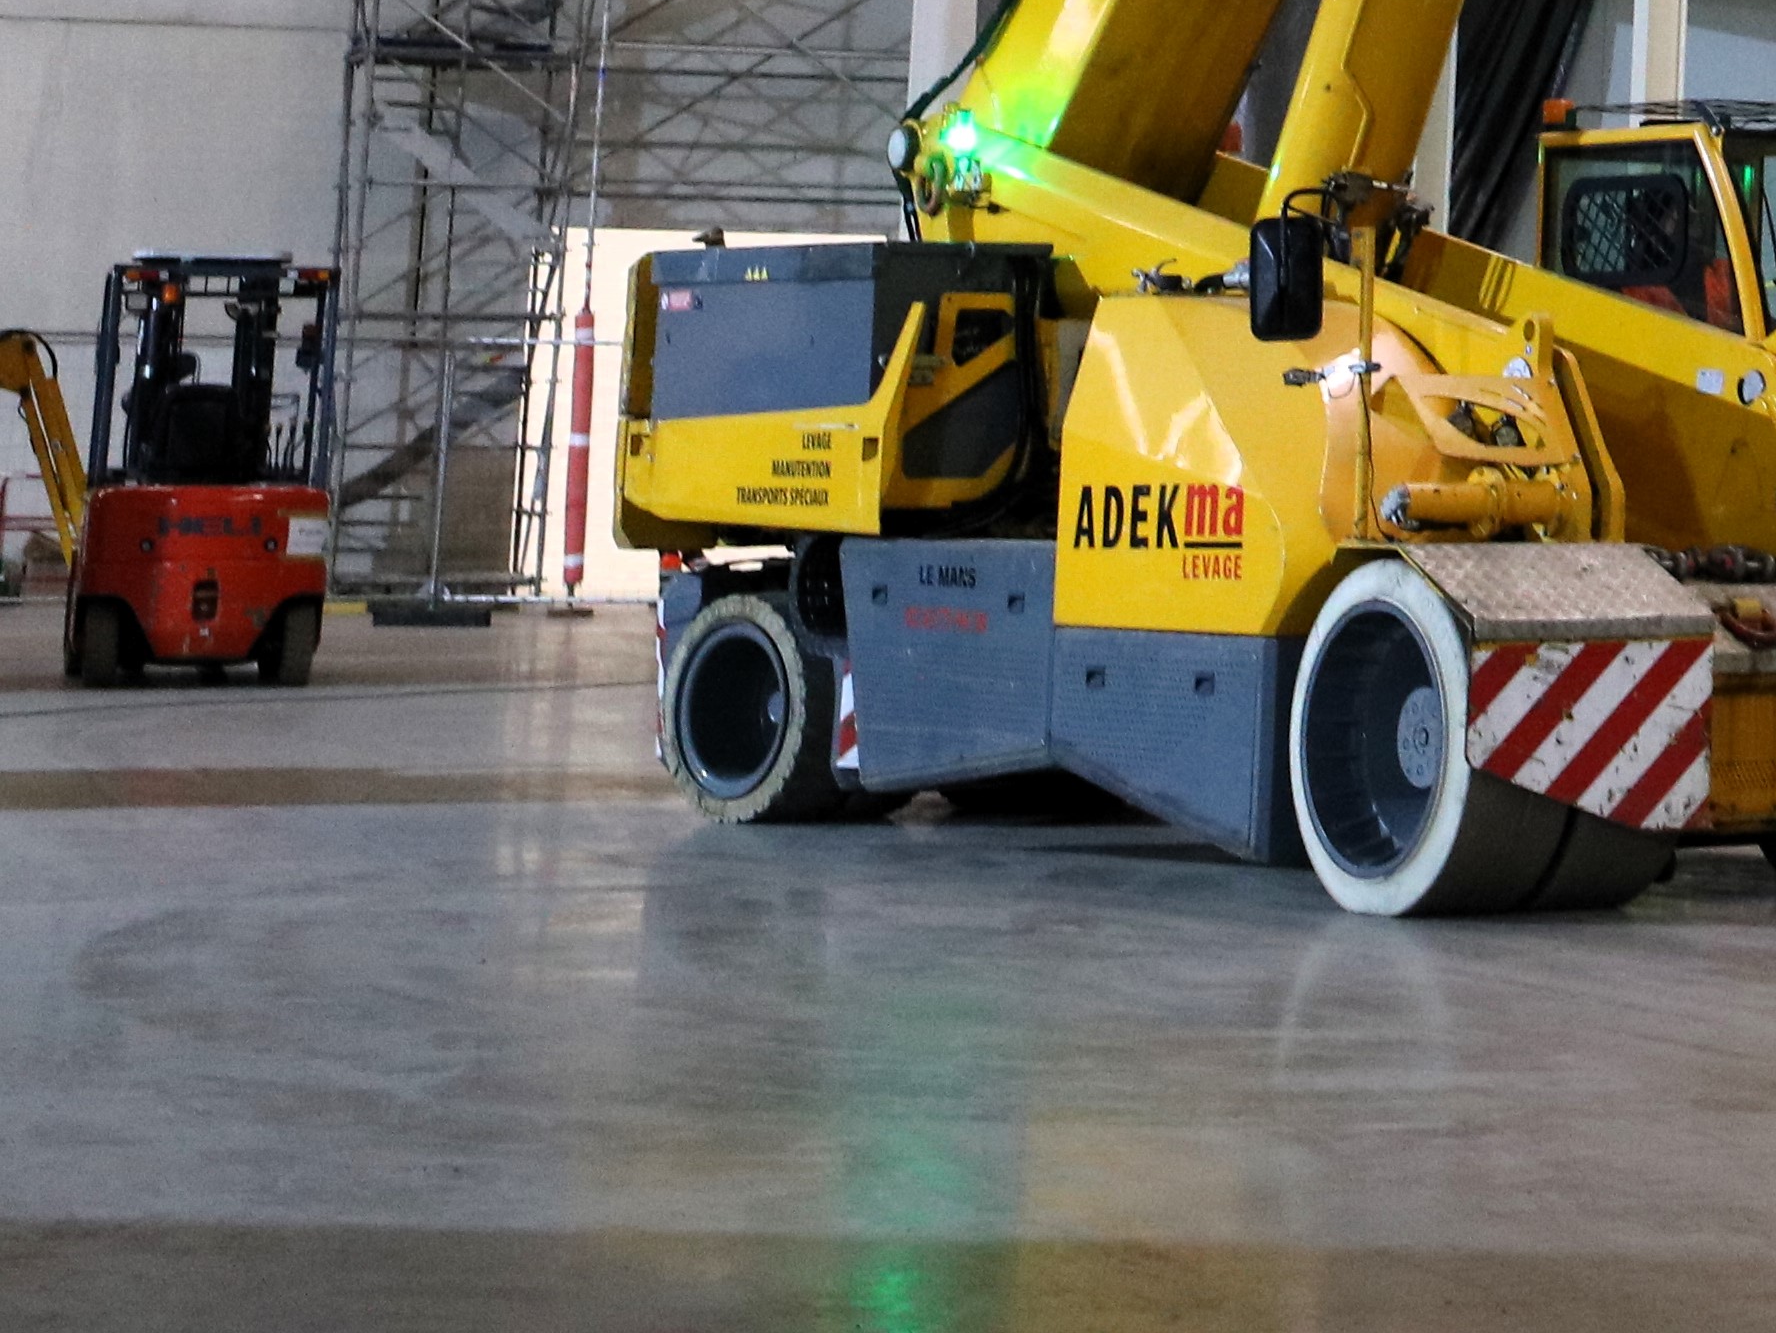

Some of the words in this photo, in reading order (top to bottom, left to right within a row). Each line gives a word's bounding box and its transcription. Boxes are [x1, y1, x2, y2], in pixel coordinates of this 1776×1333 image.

[802, 432, 832, 450] LEVAGE
[771, 460, 832, 478] MANUTENTION
[736, 486, 788, 505] TRANSPORTS
[1073, 483, 1244, 549] ADEKma
[919, 564, 934, 586] LE
[938, 564, 977, 589] MANS
[1182, 554, 1243, 580] LEVAGE
